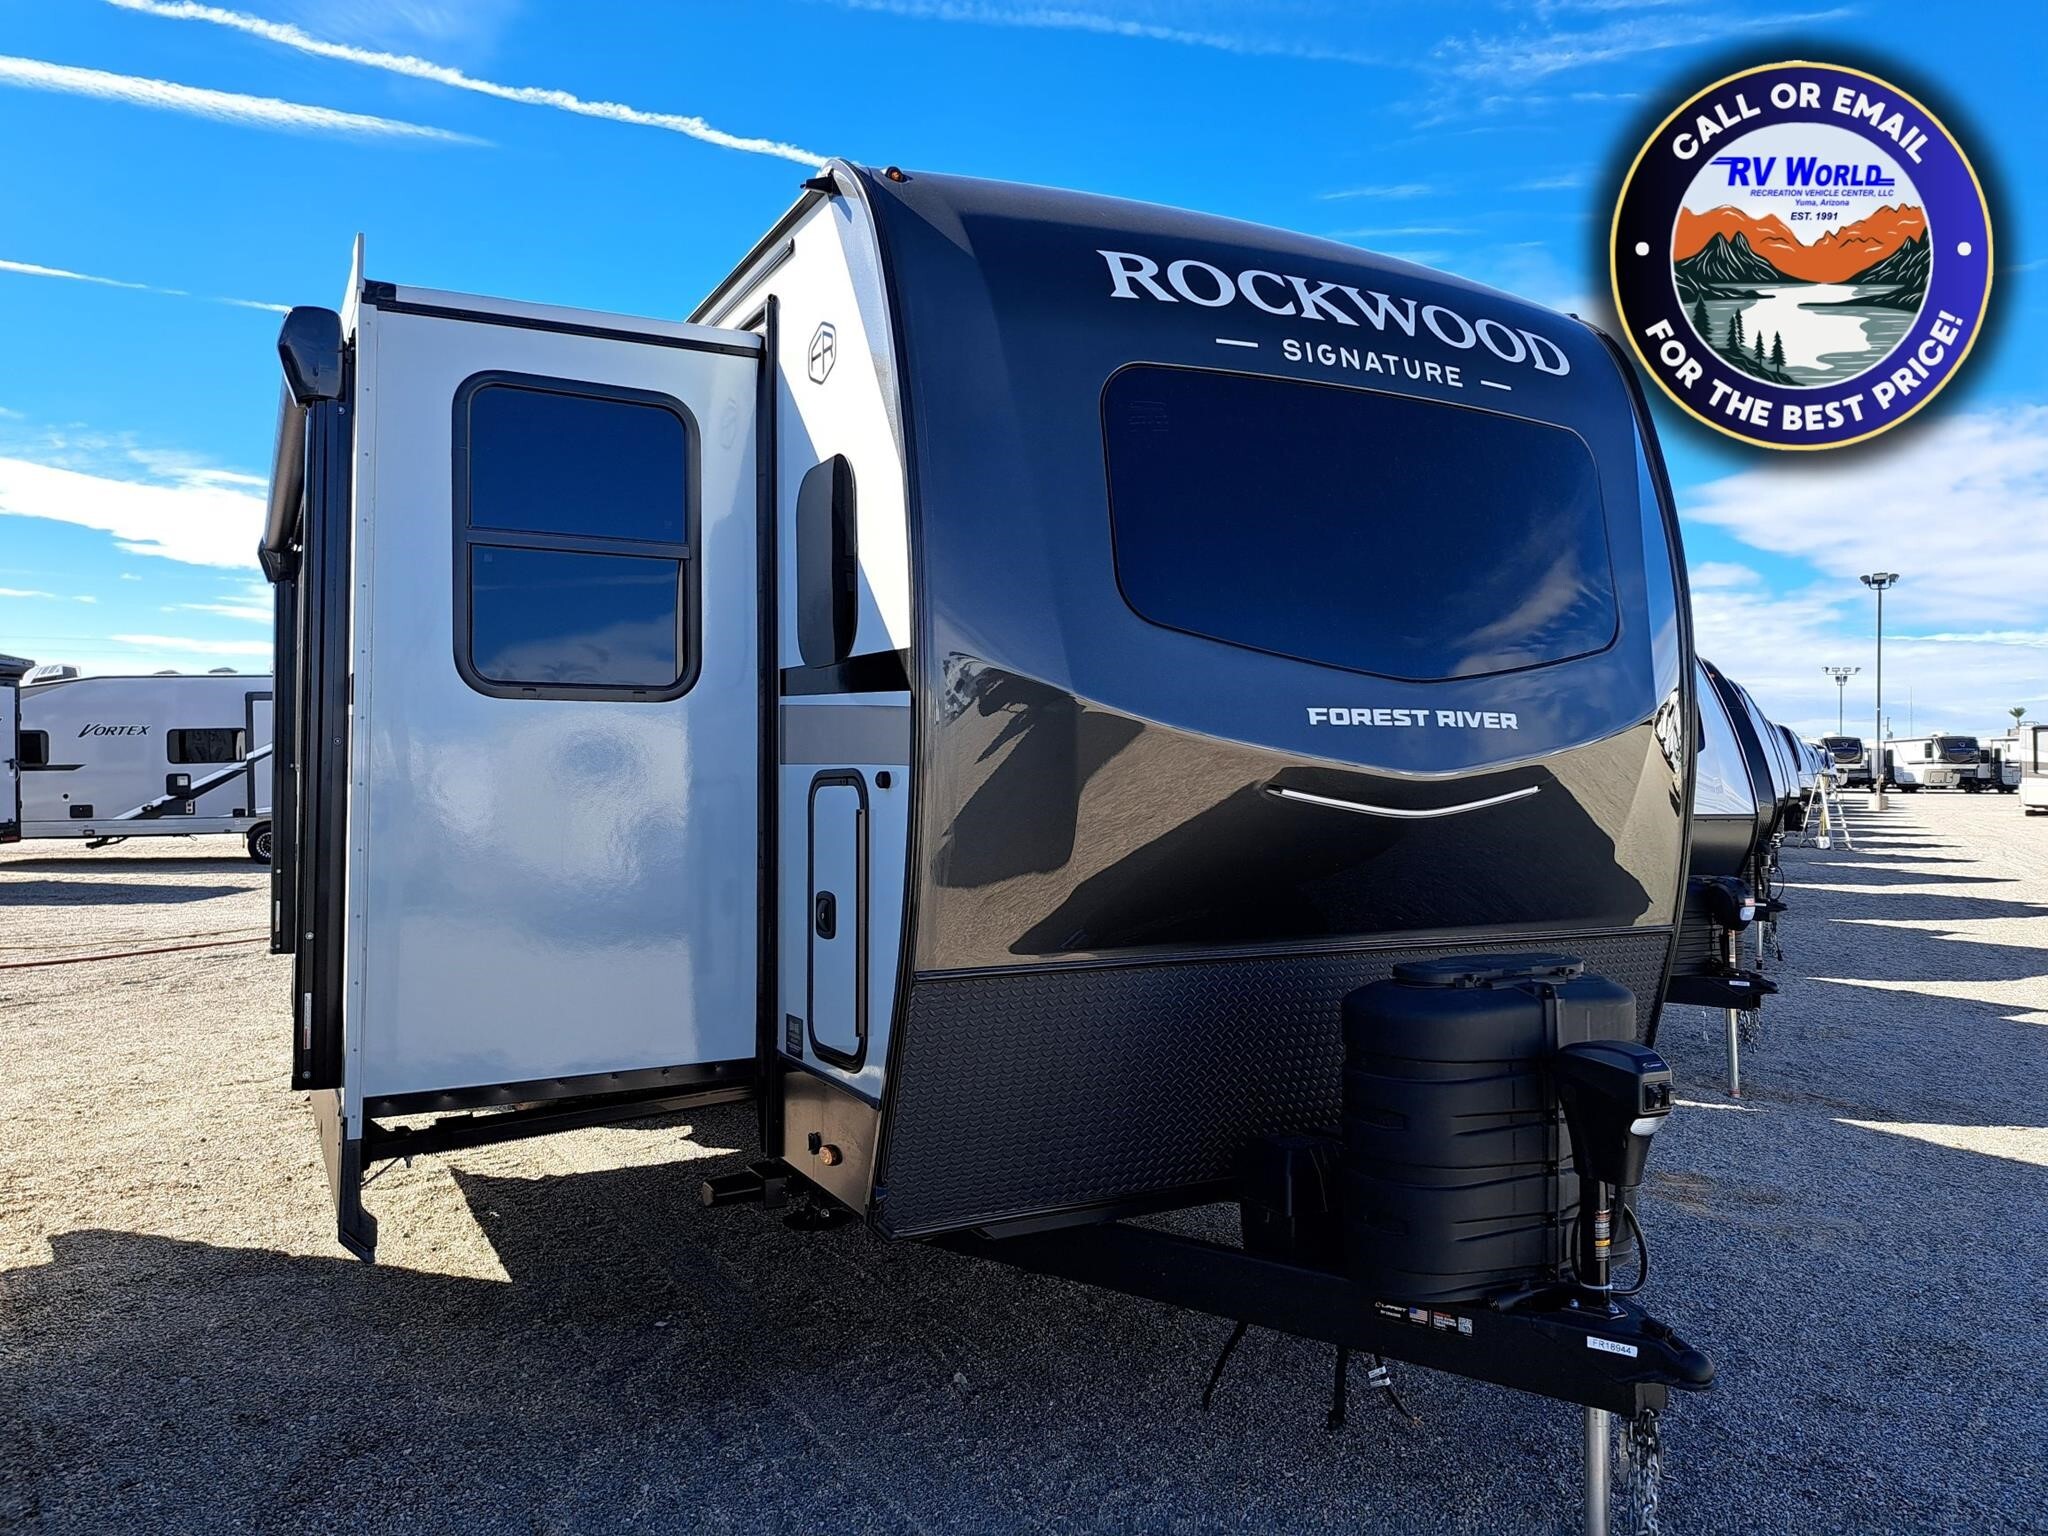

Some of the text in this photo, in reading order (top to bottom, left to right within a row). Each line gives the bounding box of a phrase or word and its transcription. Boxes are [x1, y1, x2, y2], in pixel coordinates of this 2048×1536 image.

[1096, 249, 1571, 377] ROCKWOOD
[1282, 338, 1463, 389] SIGNATURE
[1306, 707, 1519, 730] FOREST RIVER
[1592, 1339, 1632, 1354] FR18944
